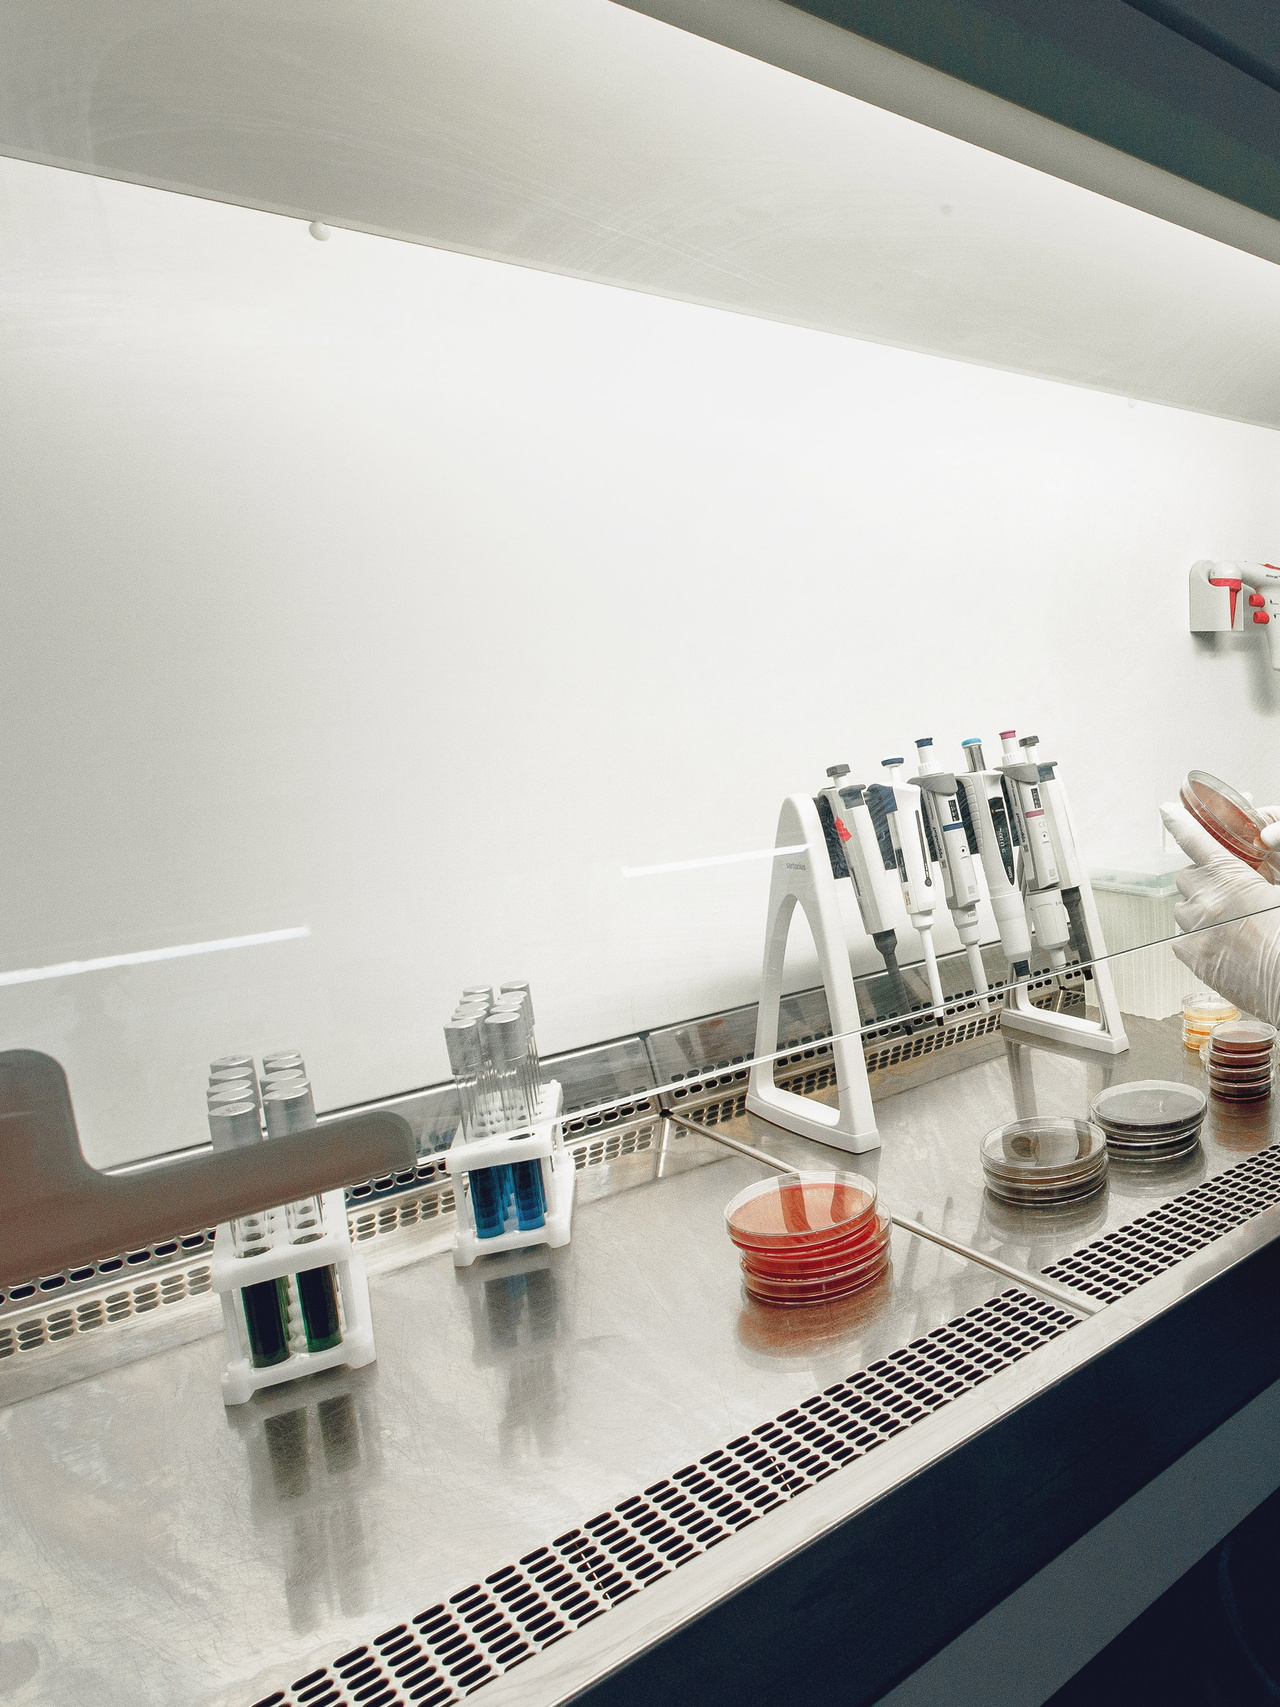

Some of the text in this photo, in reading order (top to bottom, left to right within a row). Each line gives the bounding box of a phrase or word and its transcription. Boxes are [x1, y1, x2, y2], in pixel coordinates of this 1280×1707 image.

[931, 826, 944, 859] eppendorf
[1015, 812, 1026, 843] eppendorf
[785, 861, 807, 872] sartorius
